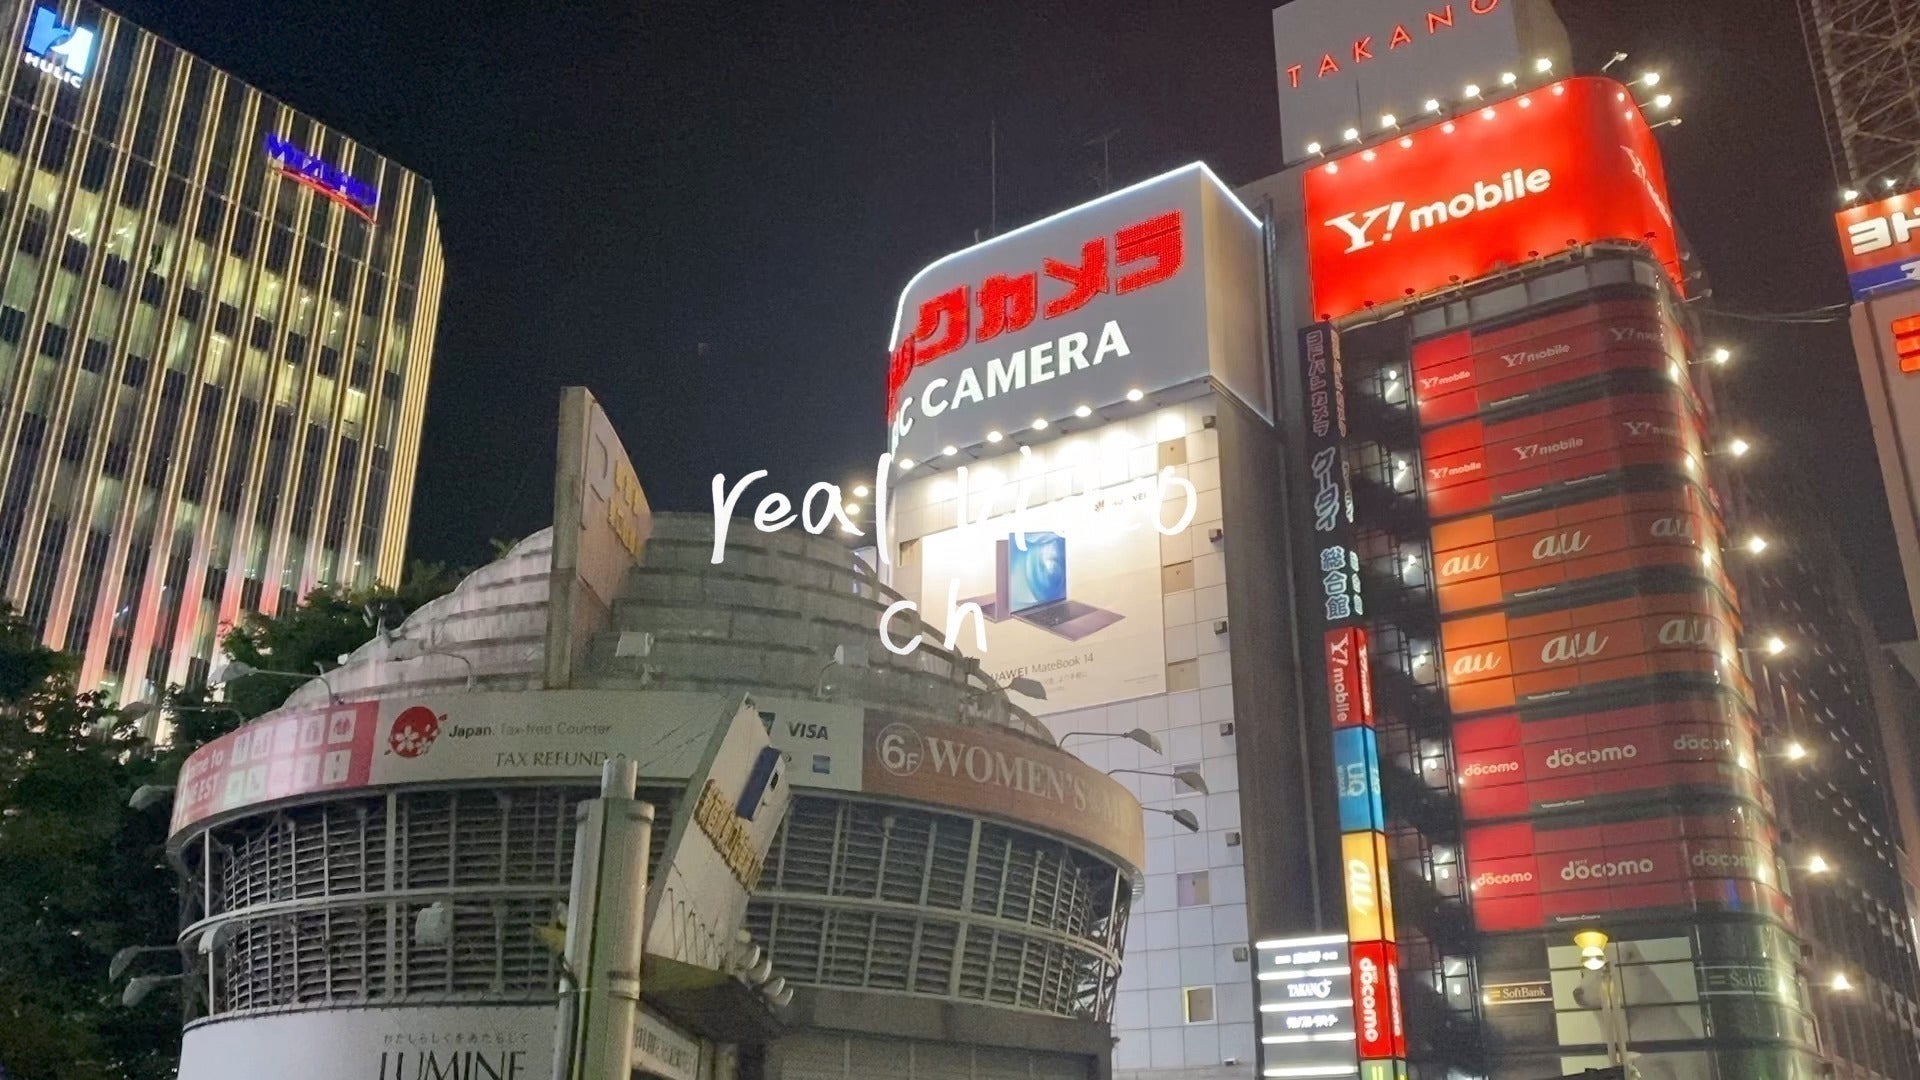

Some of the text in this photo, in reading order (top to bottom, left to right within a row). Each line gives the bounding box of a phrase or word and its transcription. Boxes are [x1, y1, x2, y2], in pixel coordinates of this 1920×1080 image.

[25, 52, 81, 88] HULIC
[1324, 168, 1551, 255] Y!mobile
[921, 320, 1131, 417] CAMERA
[1532, 529, 1591, 560] au
[1441, 552, 1490, 577] au
[1320, 545, 1350, 620] 総合館
[1541, 629, 1608, 664] au
[990, 666, 1028, 682] UAWEI
[1032, 655, 1081, 673] MateBook
[1084, 653, 1094, 663] 14
[1453, 652, 1501, 675] au
[788, 721, 829, 740] VISA
[495, 752, 529, 767] TAX
[1464, 761, 1519, 776] docomo
[1546, 744, 1637, 768] docomo
[926, 736, 1087, 811] WOMEN'S
[1477, 872, 1533, 886] docomo
[1561, 859, 1654, 880] docomo
[1359, 957, 1379, 1043] docomo
[1502, 985, 1546, 1000] SoftBank
